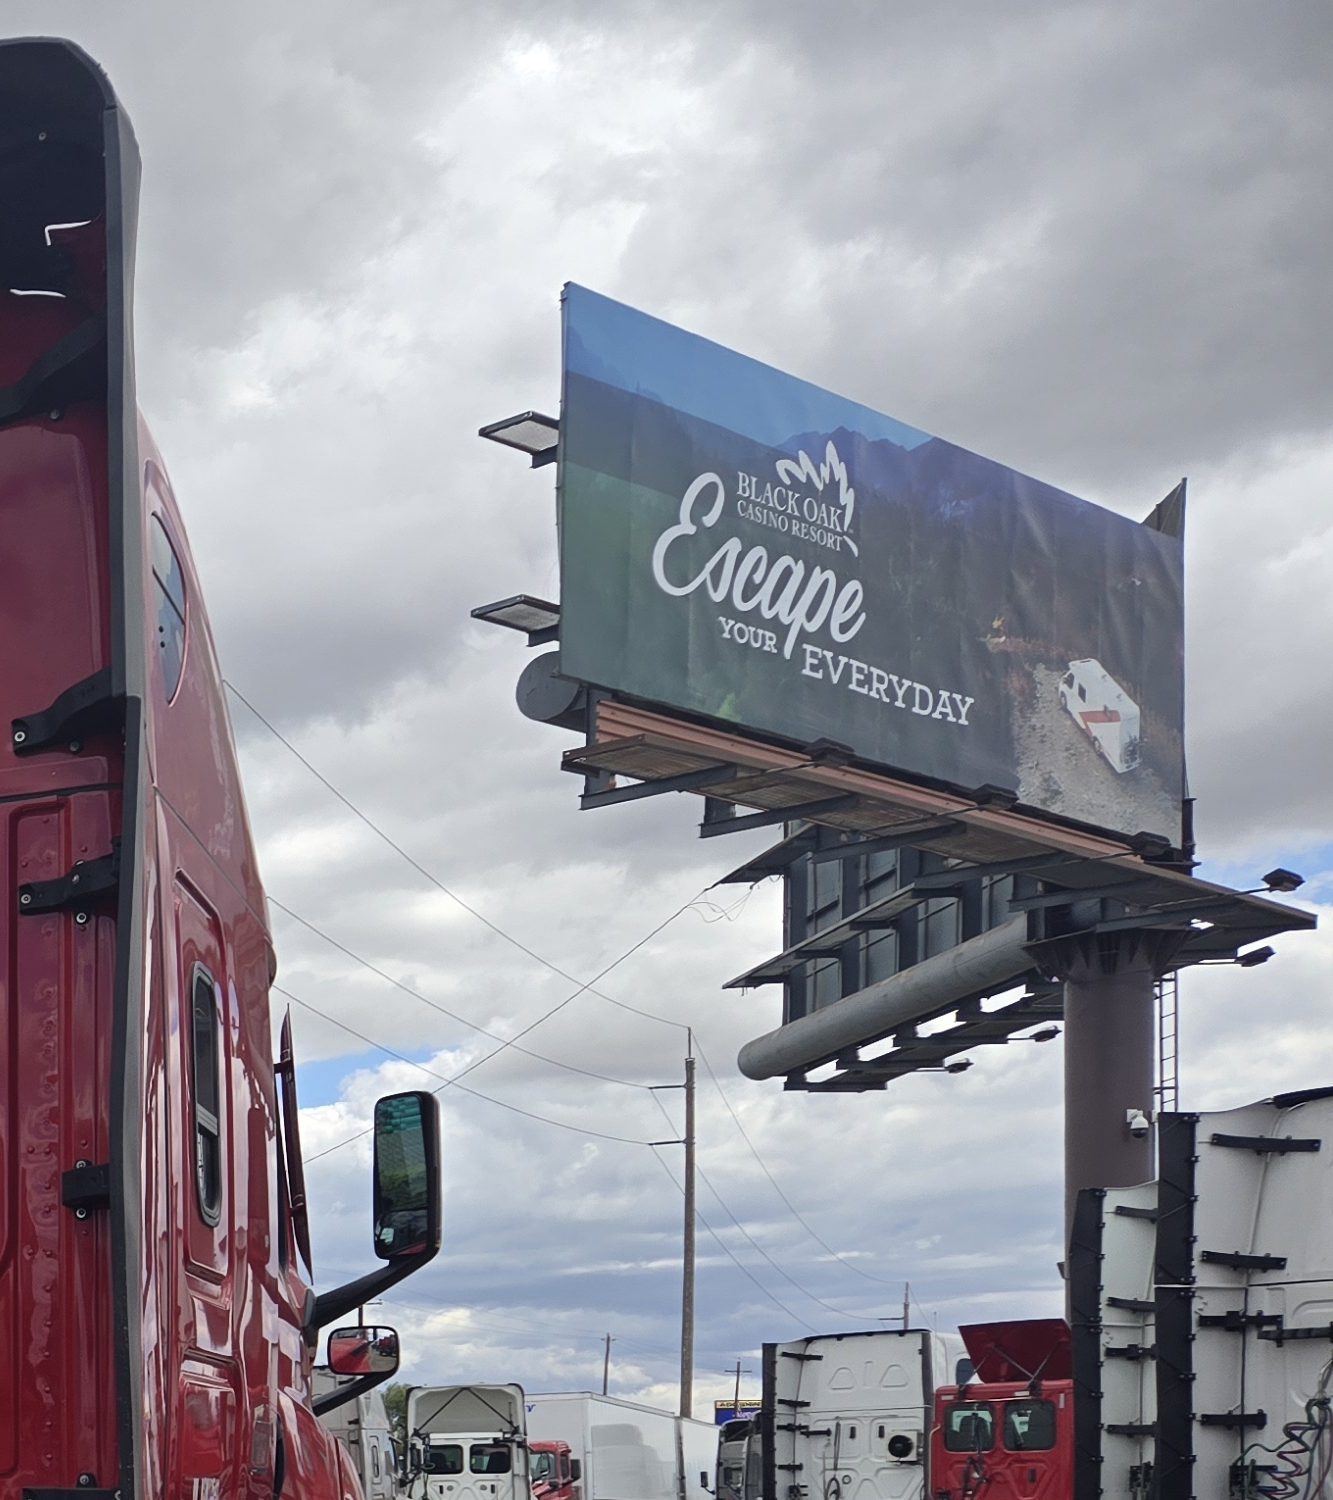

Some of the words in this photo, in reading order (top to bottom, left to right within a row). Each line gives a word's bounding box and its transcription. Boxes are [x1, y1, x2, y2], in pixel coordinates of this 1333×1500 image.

[737, 471, 800, 516] BLACK
[803, 498, 842, 532] OAK
[737, 500, 788, 531] CASINO
[792, 519, 842, 551] RESORT
[653, 472, 866, 659] Escape
[718, 617, 778, 653] YOUR
[802, 643, 974, 725] EVERYDAY
